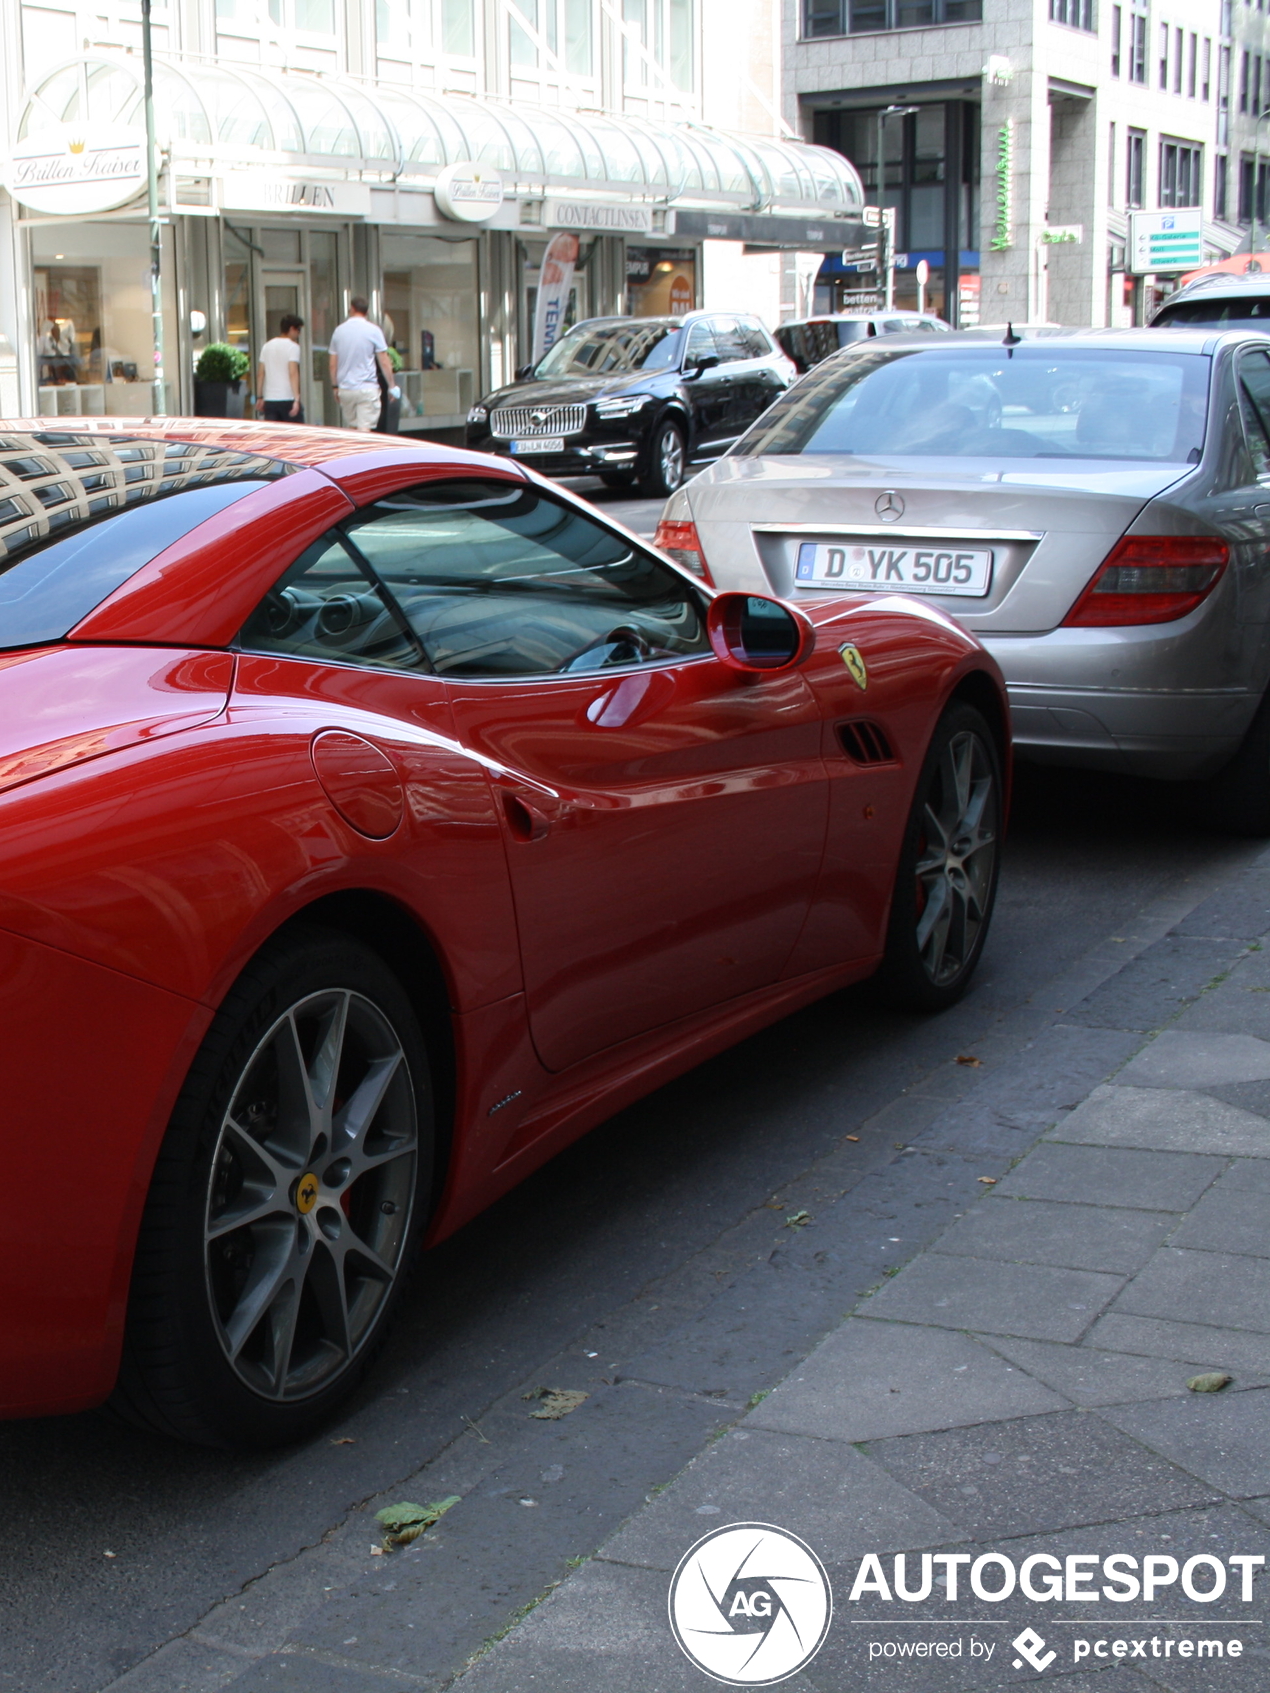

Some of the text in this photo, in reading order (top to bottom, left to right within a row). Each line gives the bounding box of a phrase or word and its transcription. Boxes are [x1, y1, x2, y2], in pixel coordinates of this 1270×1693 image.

[14, 151, 141, 183] Brillen Kaiser
[264, 183, 335, 208] BRILLEN
[556, 204, 649, 228] CONTACTLINSEN
[843, 293, 877, 305] betten
[802, 548, 974, 584] D D YK 505
